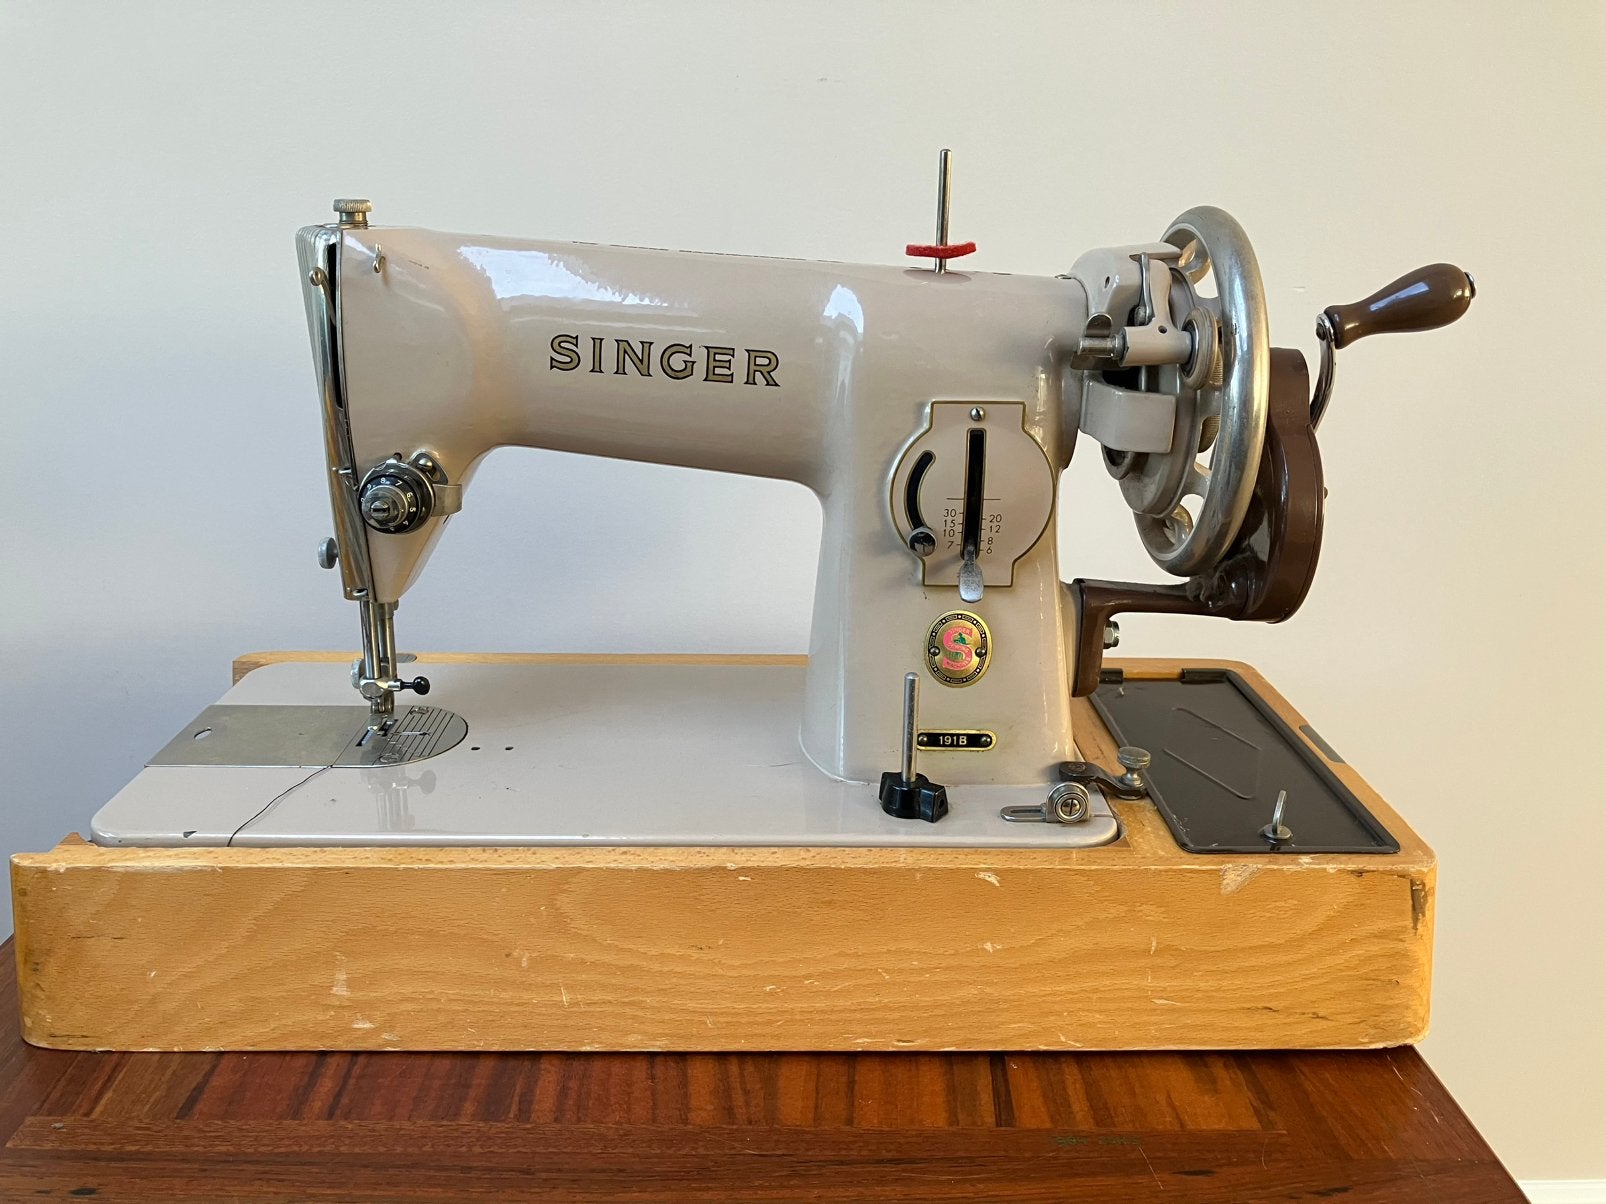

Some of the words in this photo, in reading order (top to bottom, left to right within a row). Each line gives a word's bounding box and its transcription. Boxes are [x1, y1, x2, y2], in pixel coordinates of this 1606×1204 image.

[550, 334, 781, 387] SINGER
[380, 477, 387, 485] 8
[395, 479, 403, 487] 7
[943, 508, 957, 518] 30
[989, 513, 1003, 523] 20
[943, 519, 956, 529] 15
[989, 524, 1001, 534] 12
[943, 528, 956, 538] 10
[947, 540, 955, 550] 7
[987, 536, 994, 546] 8
[986, 546, 993, 555] 6
[938, 734, 968, 746] 191B
